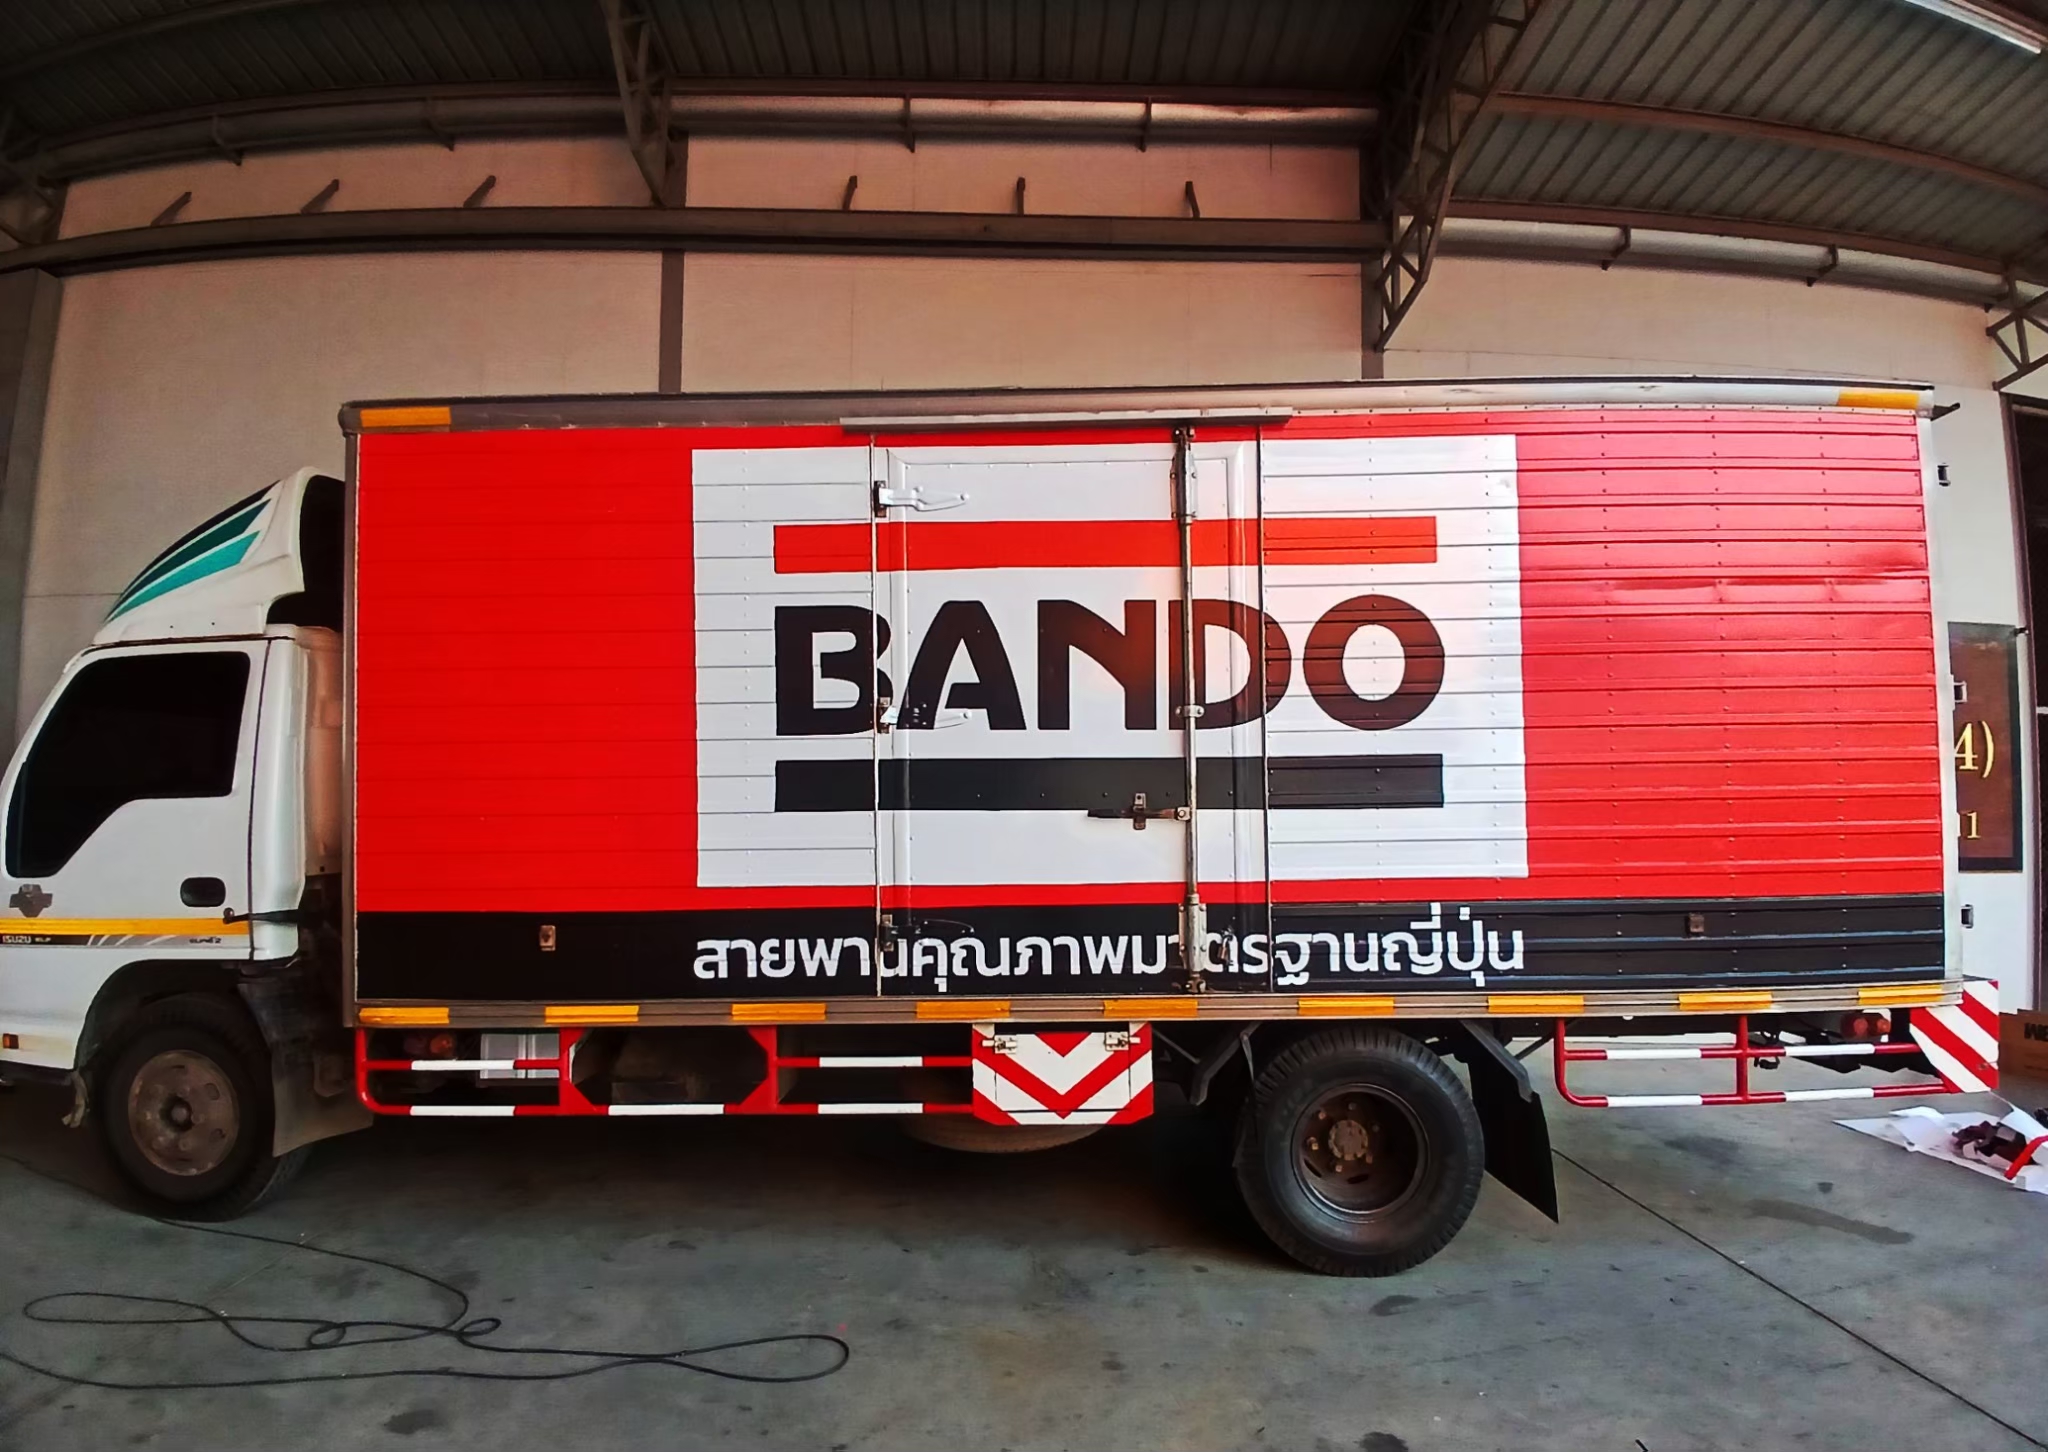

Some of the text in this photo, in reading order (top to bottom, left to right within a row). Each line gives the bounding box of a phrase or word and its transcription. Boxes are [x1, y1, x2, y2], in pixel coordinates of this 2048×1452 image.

[774, 593, 1446, 736] BANDO
[2, 935, 32, 945] ISUZU
[693, 902, 1524, 993] สายพานคุณภาพมตรฐานญี่ปุ่น
